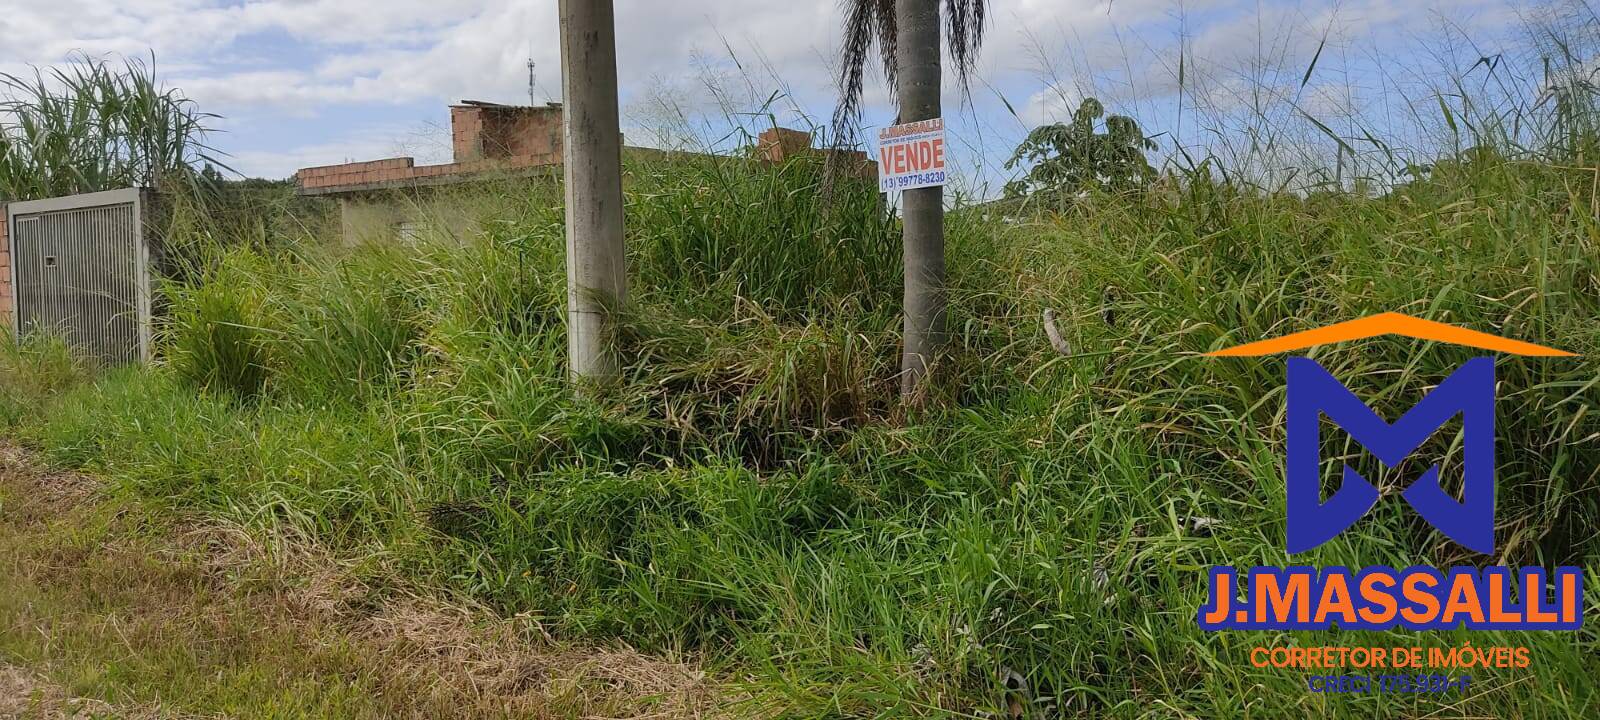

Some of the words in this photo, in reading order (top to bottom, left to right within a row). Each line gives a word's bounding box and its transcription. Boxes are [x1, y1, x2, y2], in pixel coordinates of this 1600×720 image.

[880, 138, 945, 176] VENDE
[881, 177, 897, 191] (13)
[898, 171, 945, 188] 99778-8230
